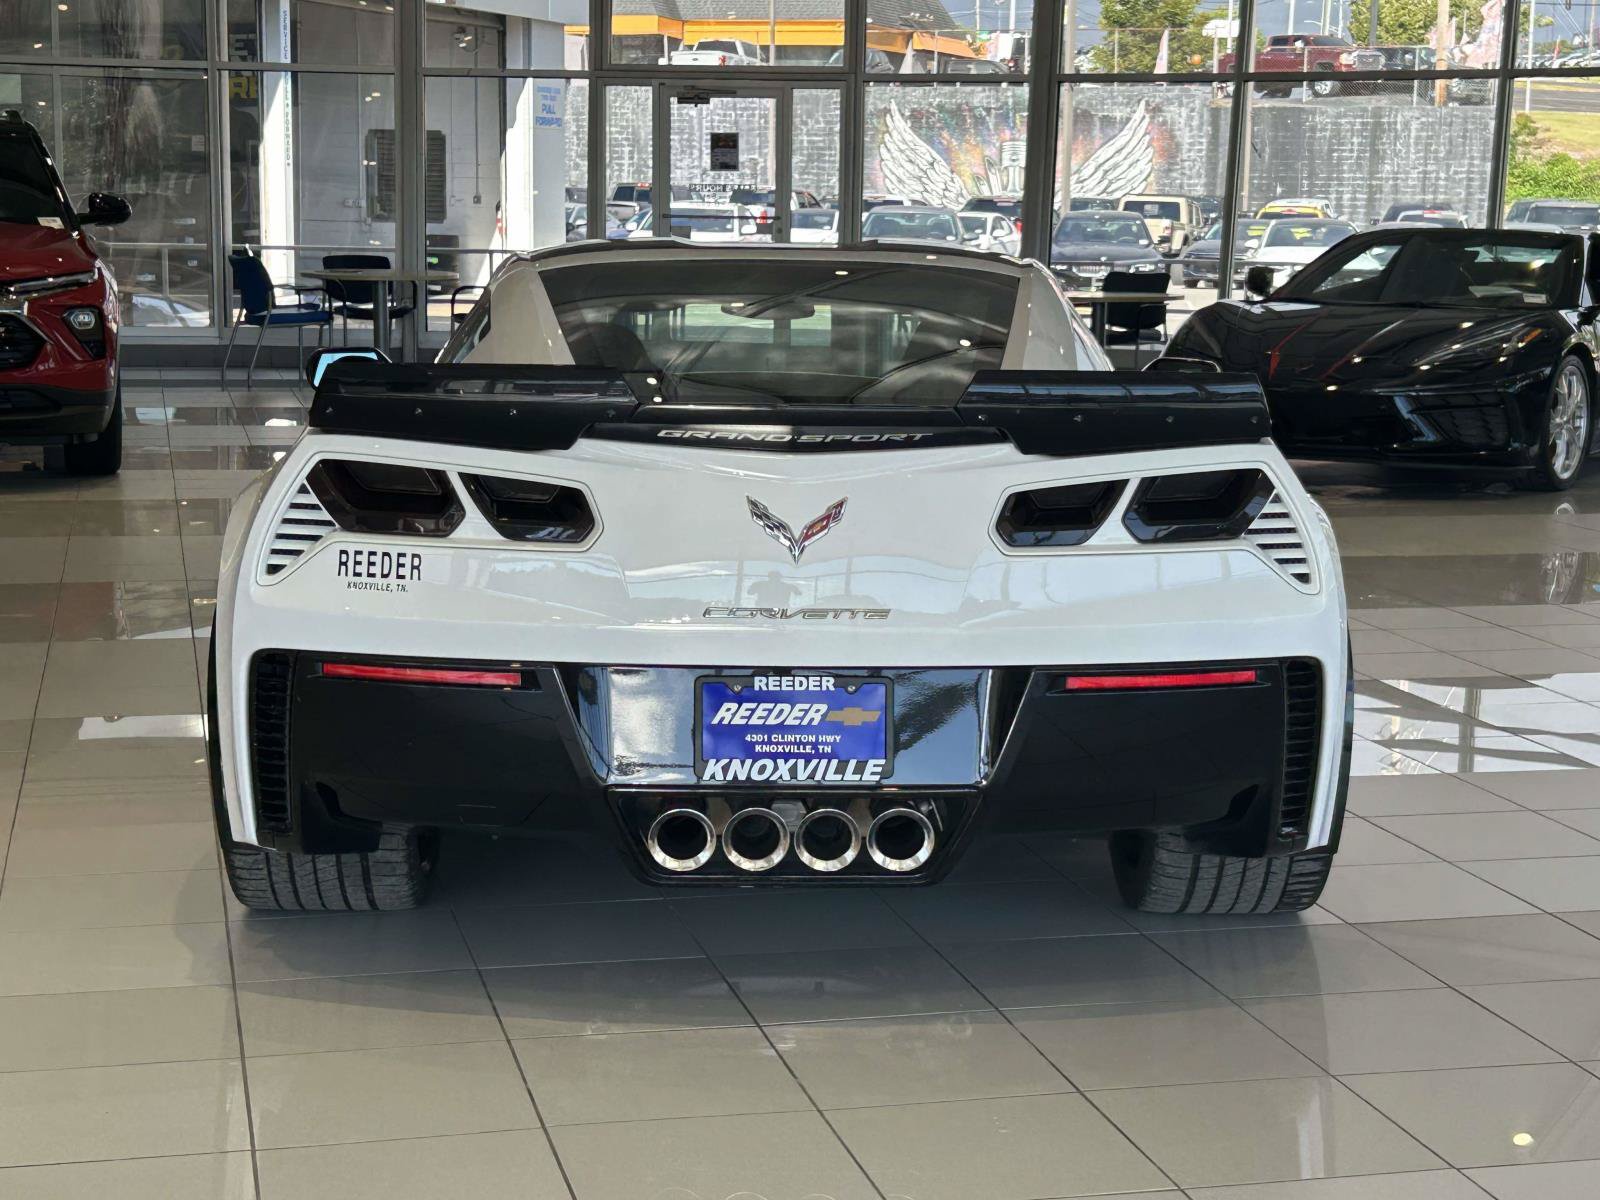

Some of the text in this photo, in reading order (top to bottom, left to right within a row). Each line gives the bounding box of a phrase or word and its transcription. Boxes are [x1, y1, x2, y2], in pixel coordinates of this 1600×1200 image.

[657, 429, 933, 443] GRAND SPORT
[337, 549, 422, 582] REEDER
[346, 581, 409, 593] KNOXVILLE, TN.
[702, 606, 891, 620] CORVETTE
[753, 676, 835, 692] REEDER
[710, 702, 828, 726] REEDER
[744, 734, 842, 743] 4301 CLINTON HWY
[754, 744, 832, 754] KNOXVILLE, TN
[701, 758, 887, 782] KNOXVILLE
